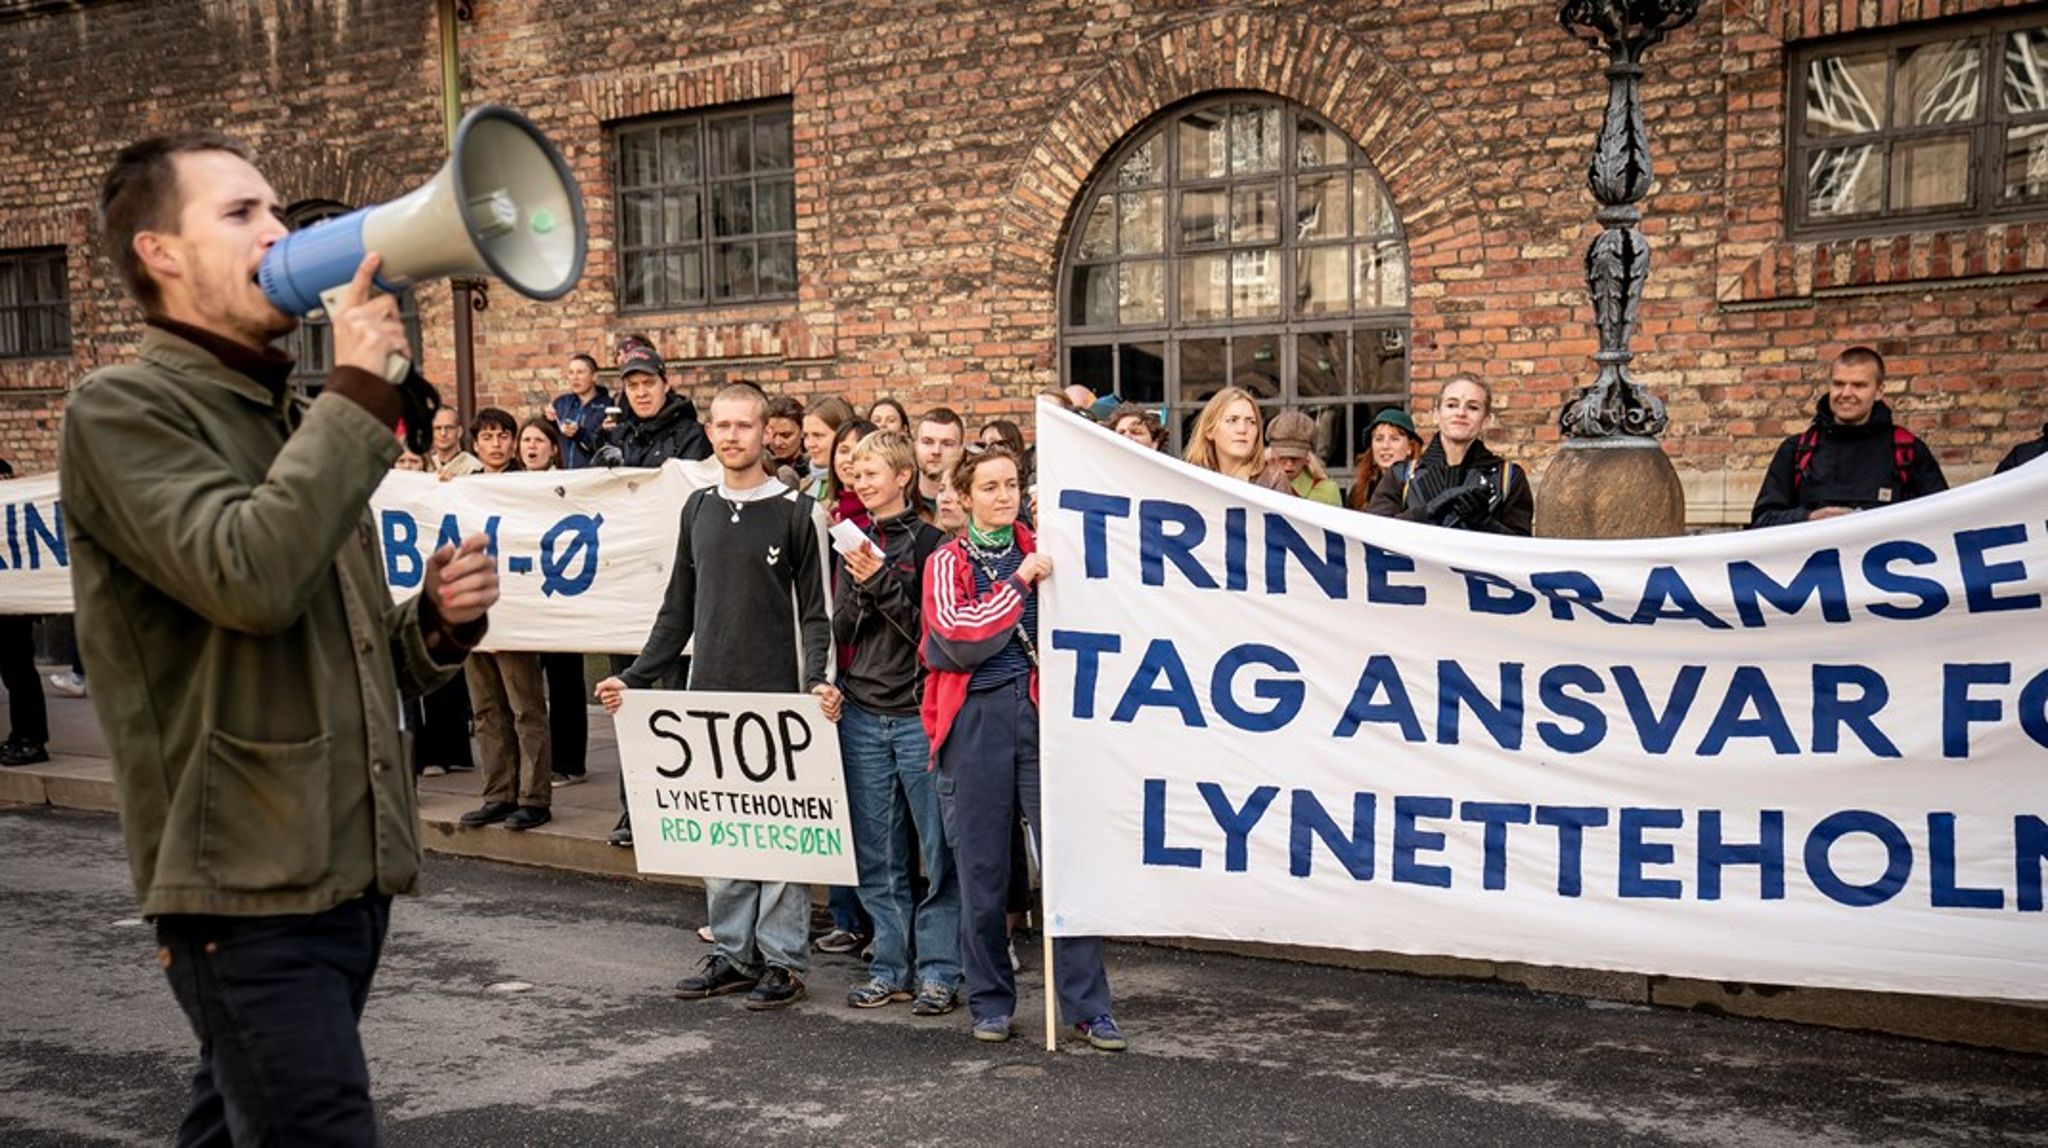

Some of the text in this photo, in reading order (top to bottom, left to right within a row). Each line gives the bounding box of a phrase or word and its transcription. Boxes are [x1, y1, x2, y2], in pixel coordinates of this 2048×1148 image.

[0, 500, 69, 570] IN
[1059, 489, 2048, 629] TRINE BRAMSE
[1051, 629, 2048, 759] TAG ANSVAR F
[648, 709, 812, 782] STOP
[656, 788, 833, 820] LYNETTEHOLMEN
[660, 817, 843, 856] RED ØSTERSØEN
[1142, 778, 2048, 912] LYNETTEHOL
